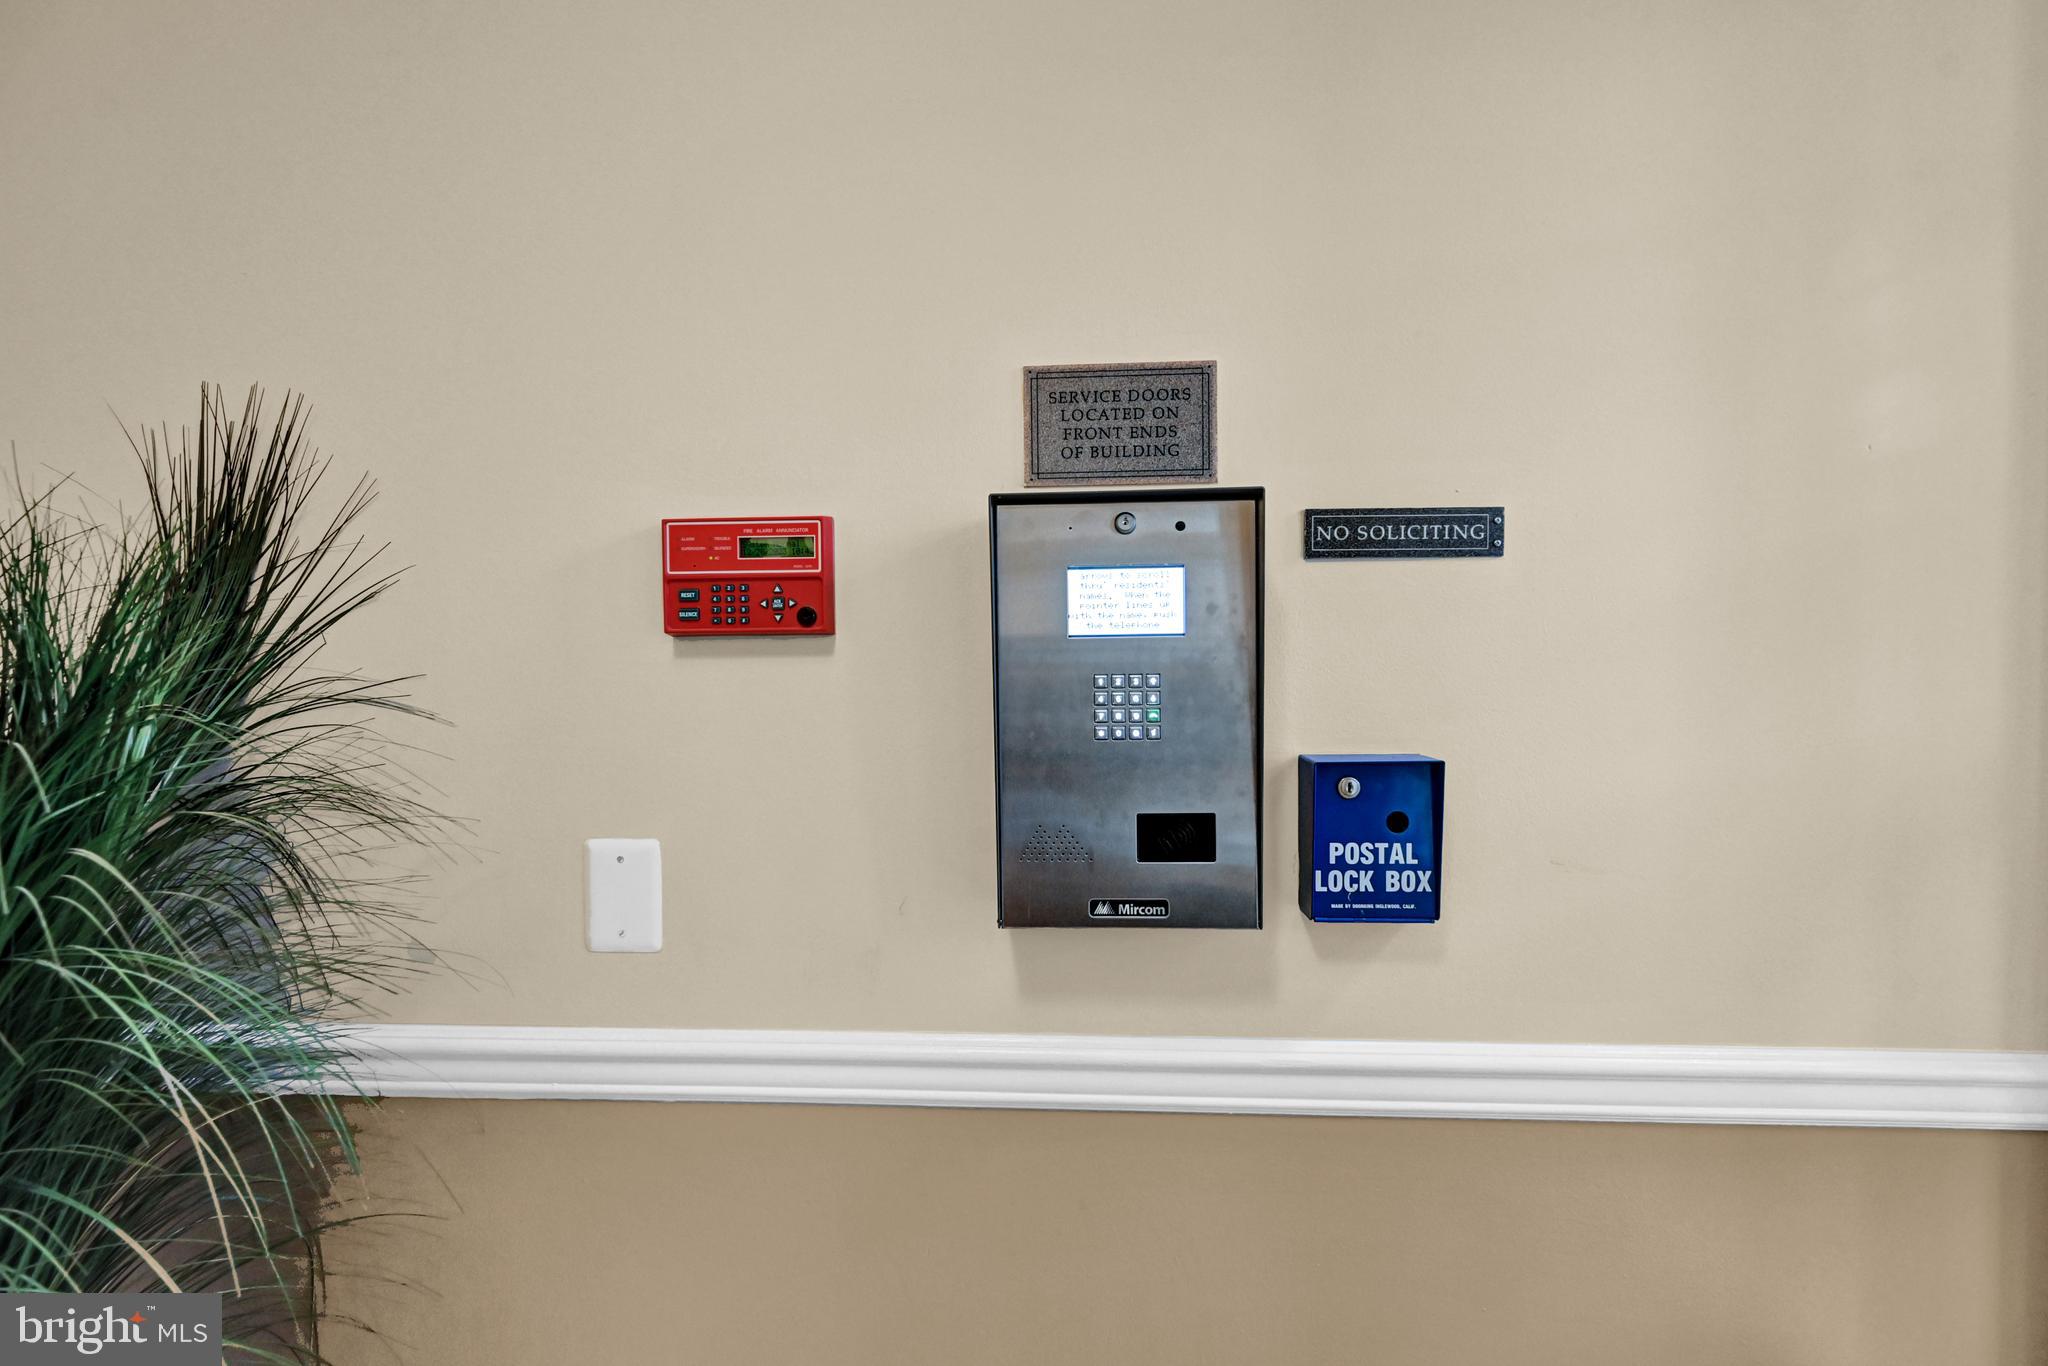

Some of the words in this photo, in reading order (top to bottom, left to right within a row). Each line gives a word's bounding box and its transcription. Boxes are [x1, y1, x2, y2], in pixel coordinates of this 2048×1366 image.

[1048, 390, 1121, 404] SERVICE
[1128, 388, 1191, 401] DOORS
[1060, 407, 1145, 422] LOCATED
[1152, 406, 1180, 420] ON
[1063, 427, 1123, 440] FRONT
[1130, 425, 1178, 439] ENDS
[1060, 446, 1084, 460] OF
[1090, 444, 1180, 459] BUILDING
[1315, 525, 1349, 541] NO
[1357, 523, 1485, 540] SOLICITING
[1329, 842, 1418, 865] POSTAL
[1315, 870, 1374, 892] LOCK
[1385, 870, 1432, 892] BOX
[1118, 903, 1166, 915] Mircom
